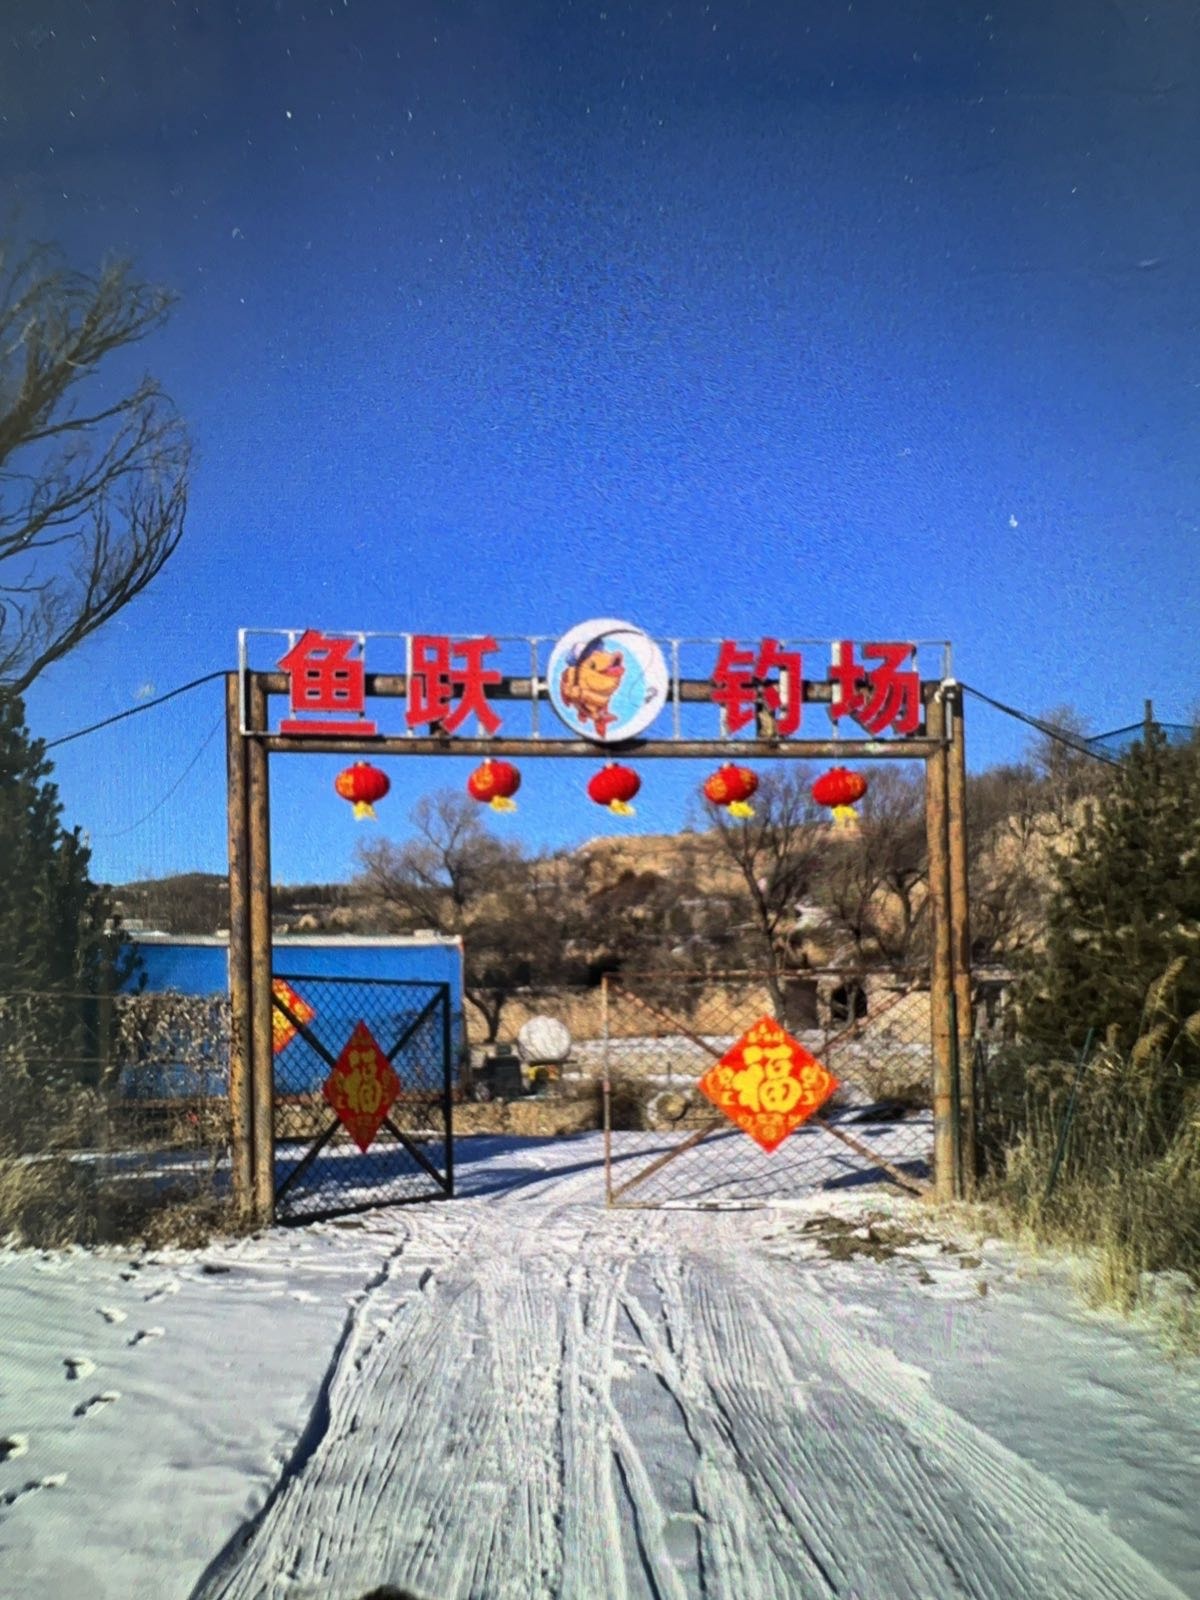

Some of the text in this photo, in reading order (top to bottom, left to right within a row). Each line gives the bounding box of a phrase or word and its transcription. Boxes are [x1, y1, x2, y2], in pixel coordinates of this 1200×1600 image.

[277, 628, 920, 735] 鱼跃 钓场
[340, 1048, 383, 1115] 福
[732, 1044, 802, 1114] 福
